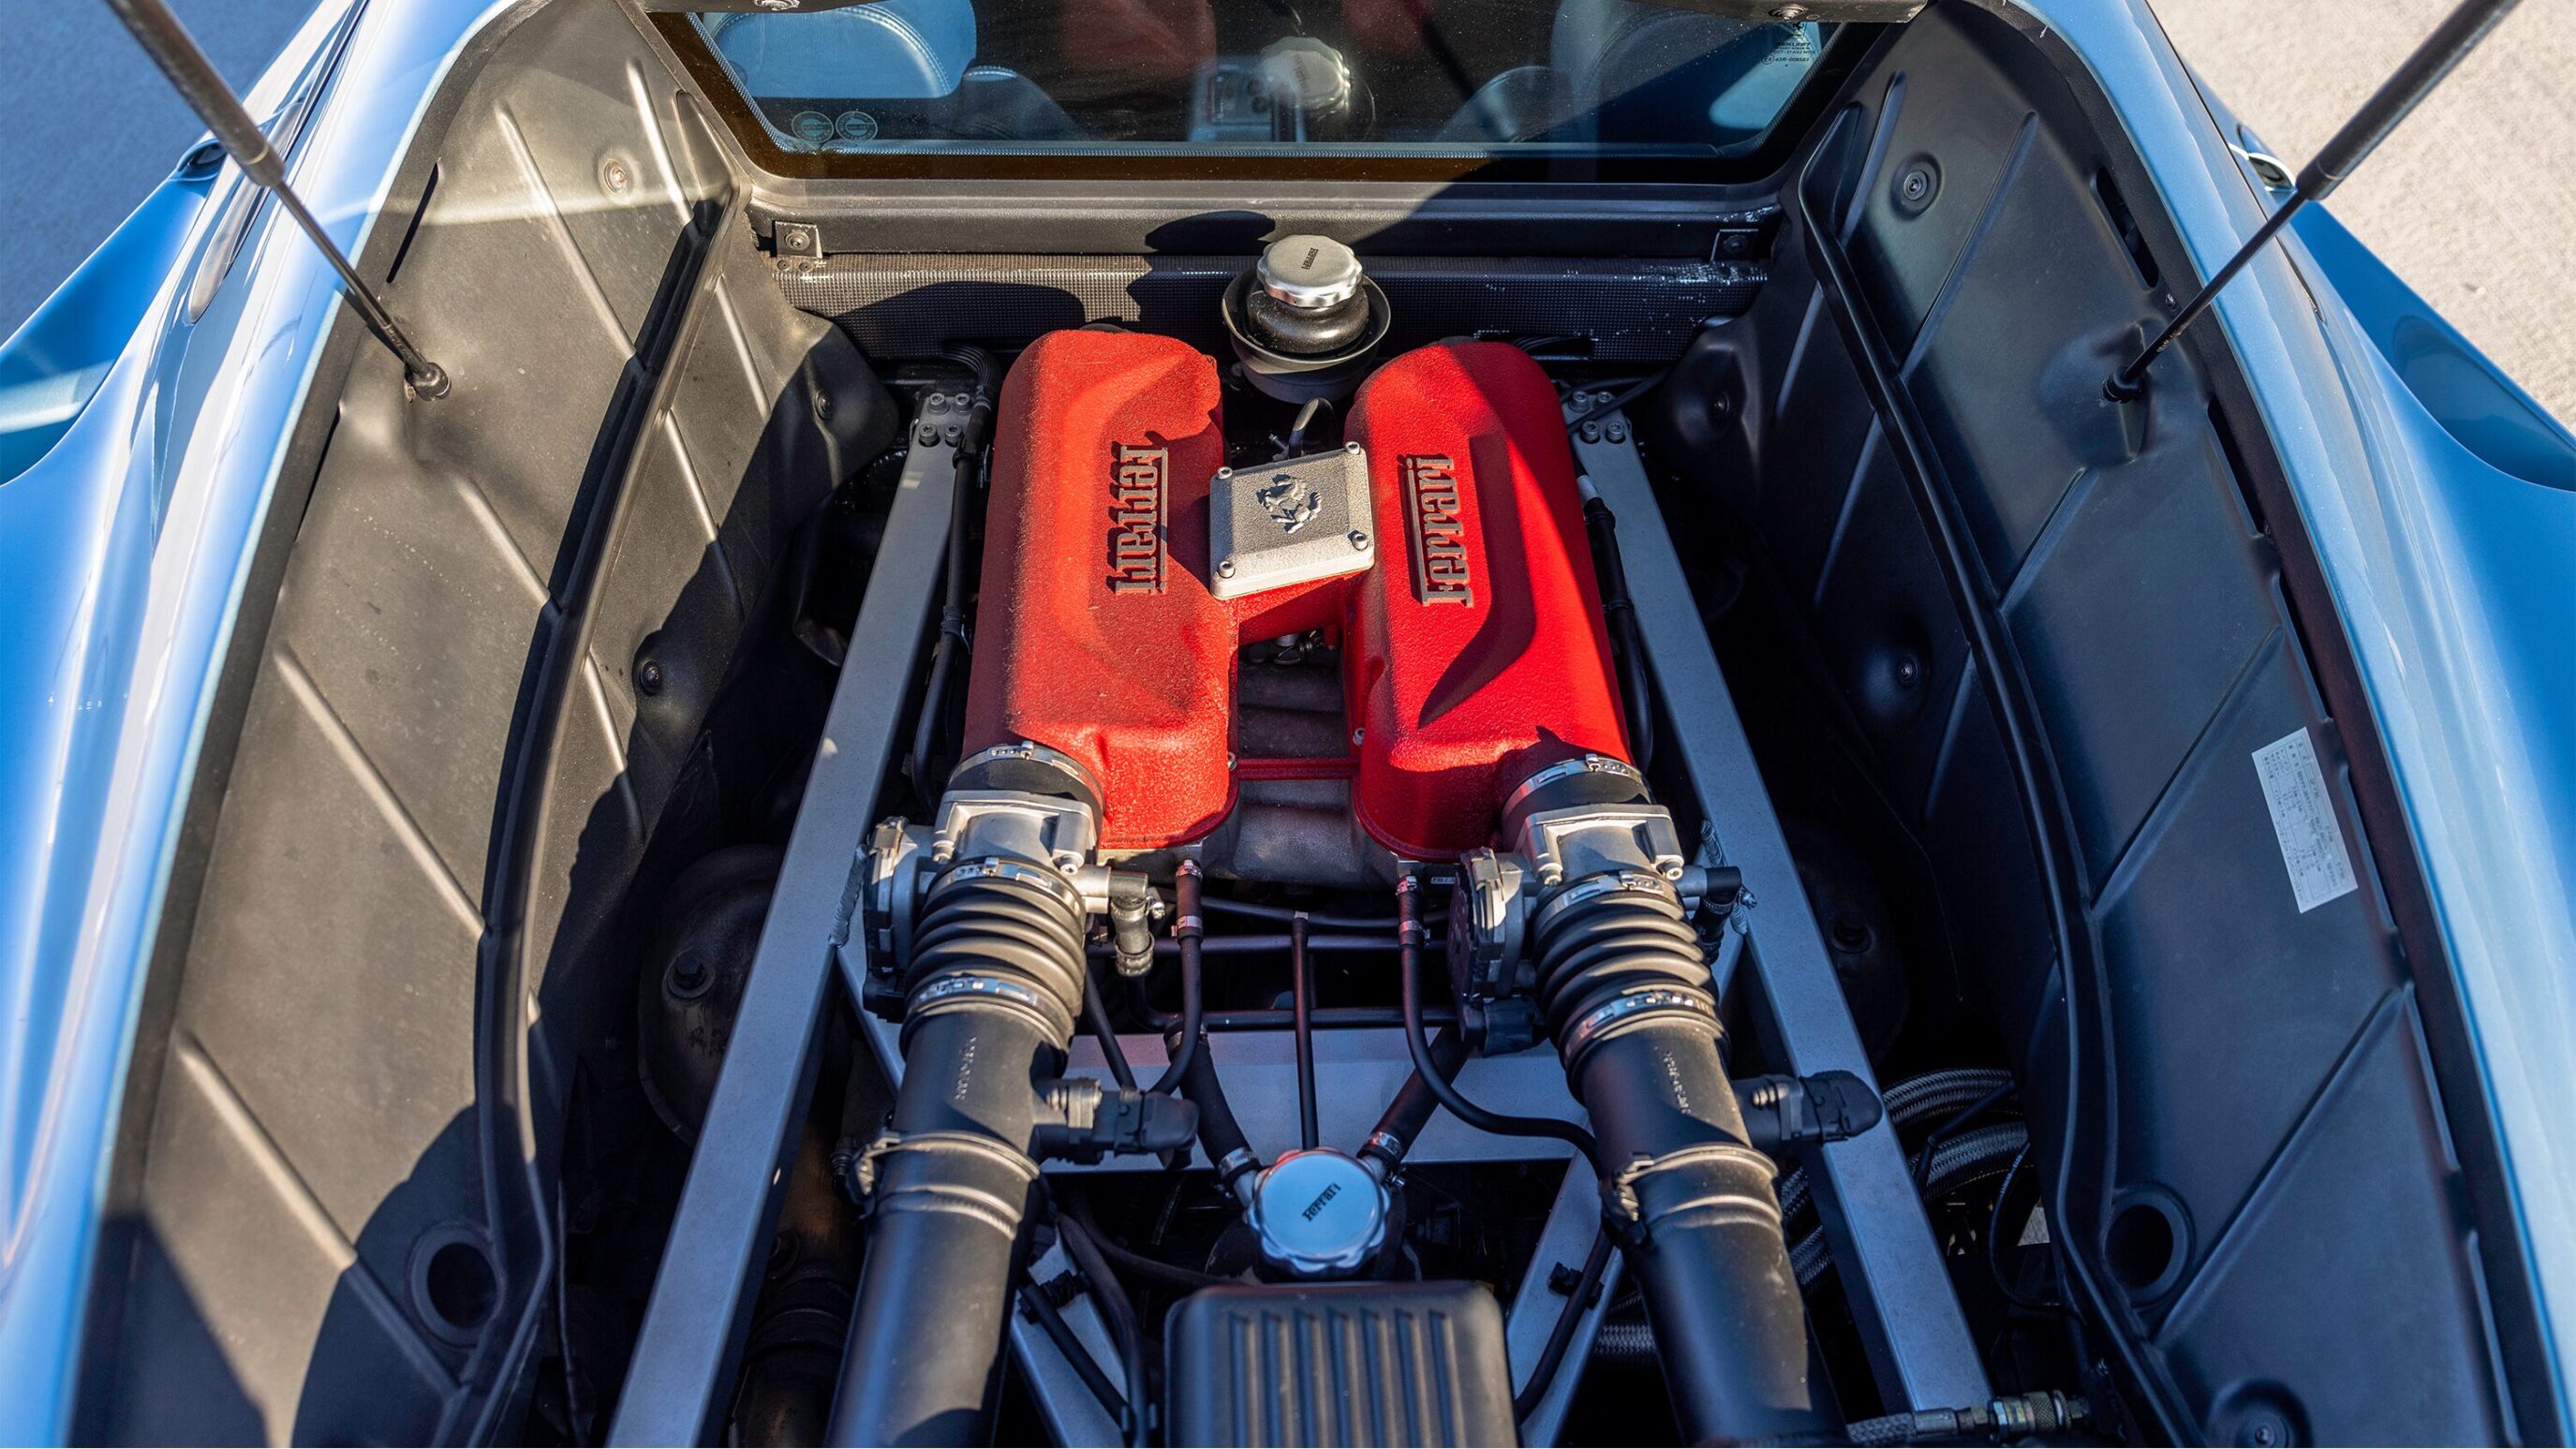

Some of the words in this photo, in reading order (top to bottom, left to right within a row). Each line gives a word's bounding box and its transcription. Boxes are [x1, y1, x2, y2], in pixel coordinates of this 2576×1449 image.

[1116, 445, 1168, 596] Ferrari
[1406, 456, 1473, 609] Ferrari
[1301, 1183, 1341, 1221] Ferrari
